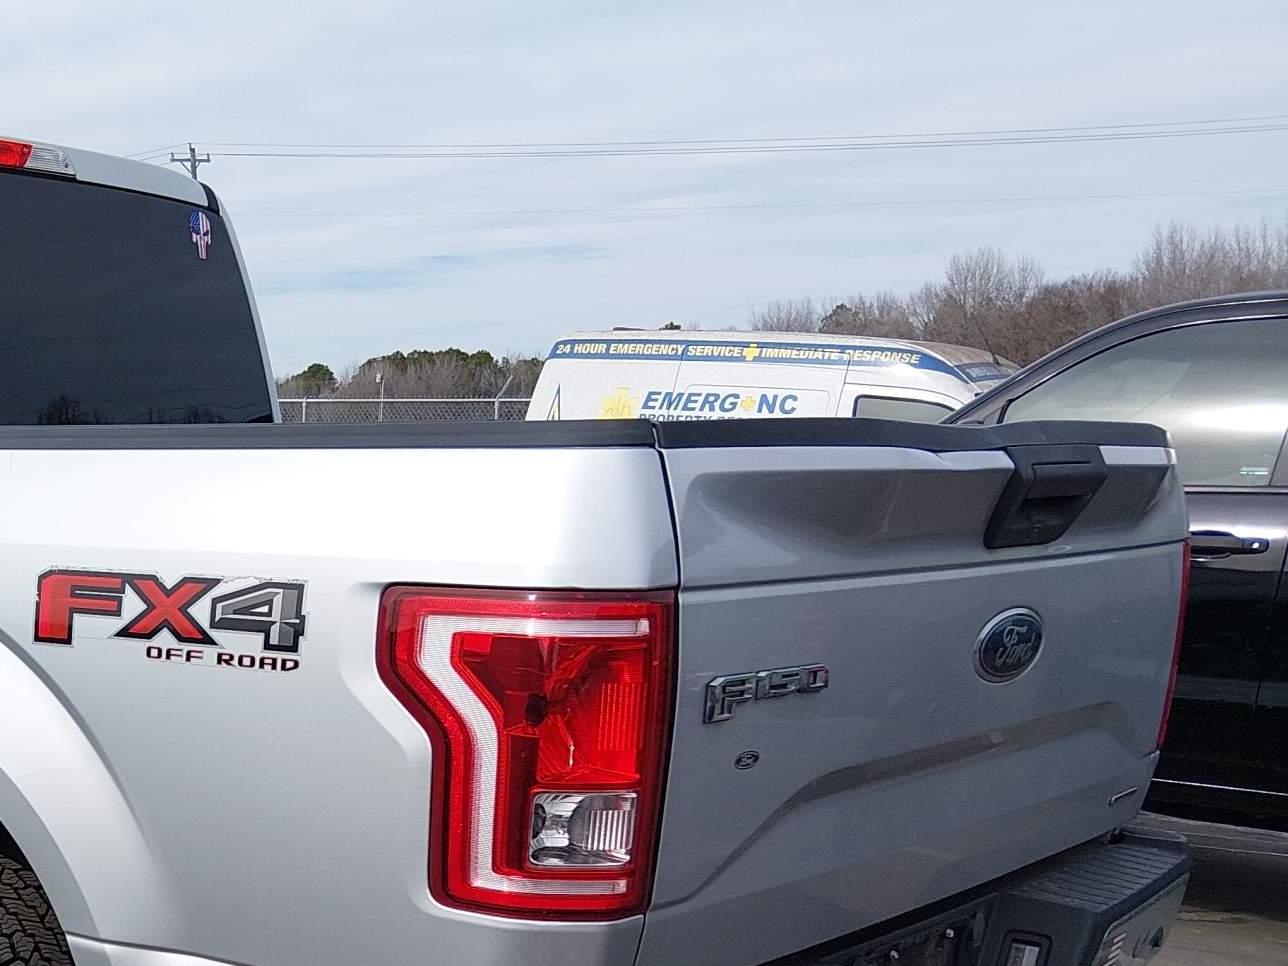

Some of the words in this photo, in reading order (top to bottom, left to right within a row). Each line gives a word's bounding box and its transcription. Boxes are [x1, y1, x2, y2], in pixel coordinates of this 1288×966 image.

[556, 344, 570, 353] 24
[573, 344, 606, 354] HOUR
[609, 344, 684, 356] EMERGENCY
[687, 346, 742, 357] SERVICE
[761, 348, 840, 360] IMMEDIATE
[32, 569, 306, 653] FX4
[146, 646, 204, 662] OFF
[216, 652, 299, 672] ROAD
